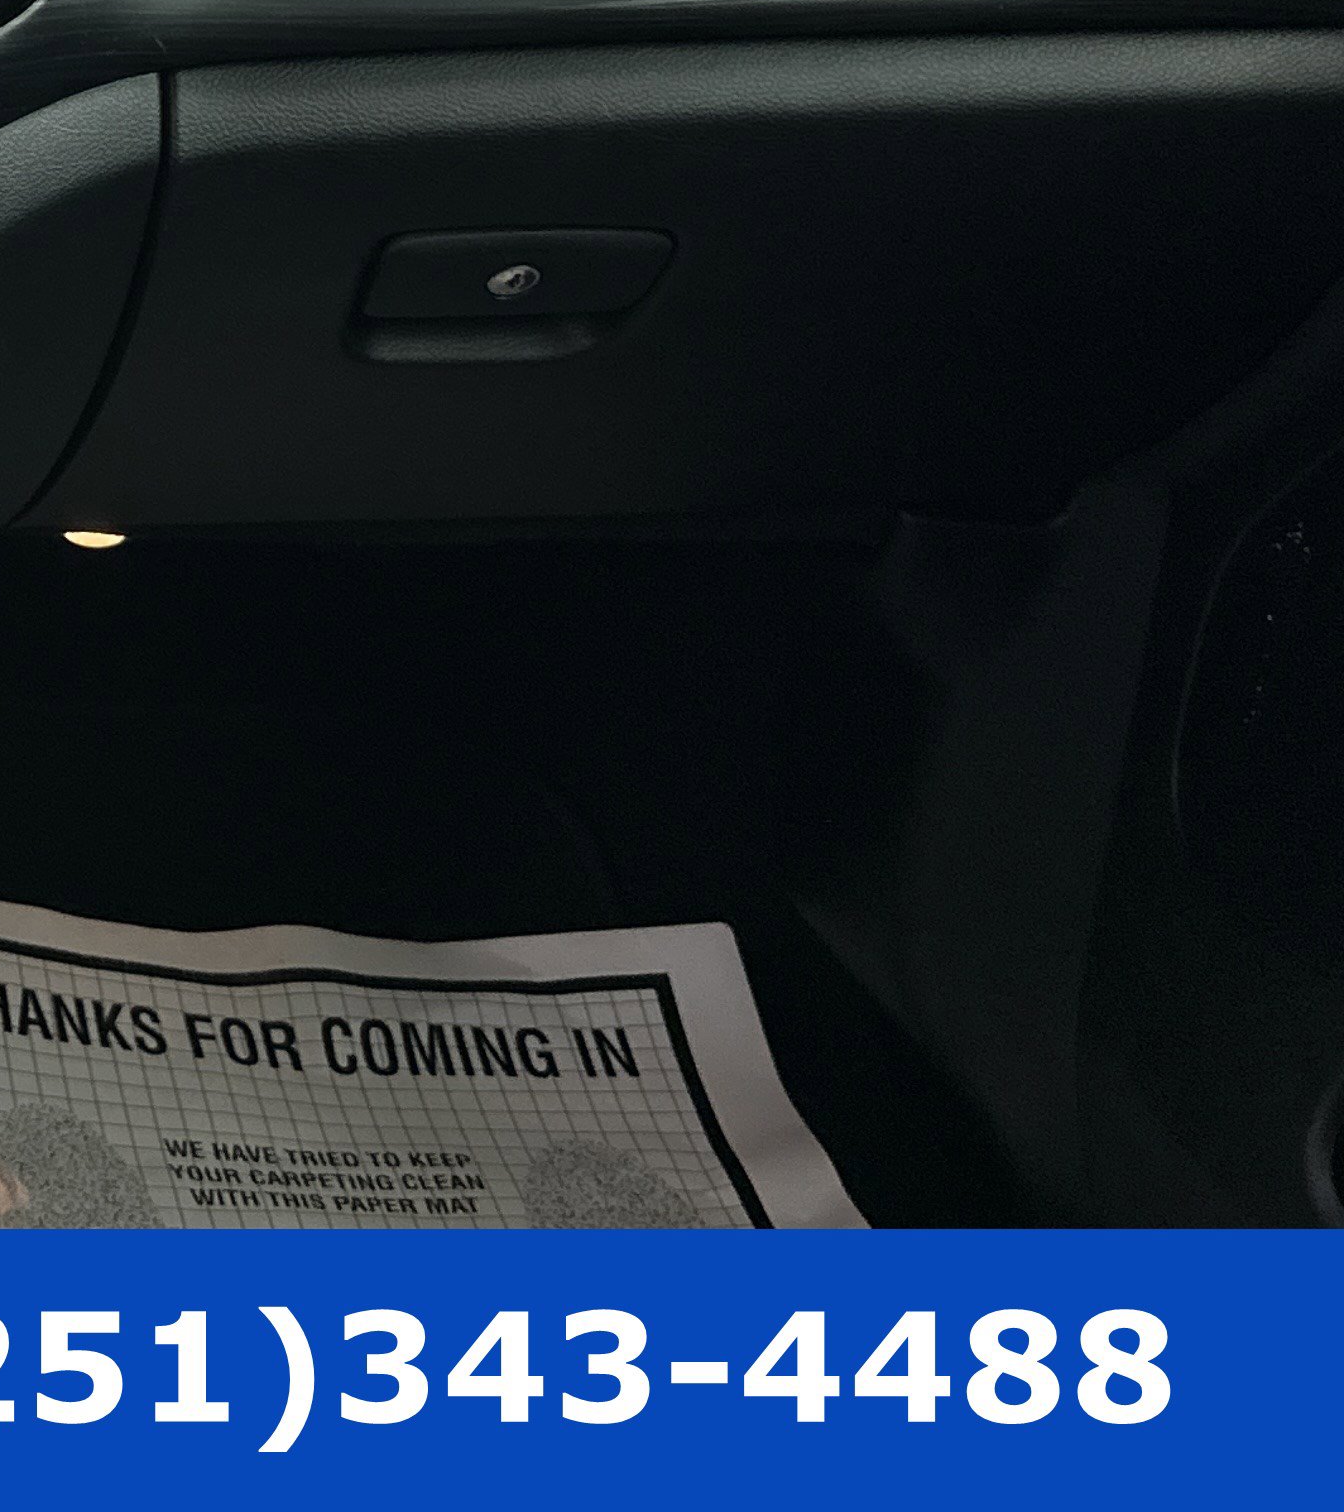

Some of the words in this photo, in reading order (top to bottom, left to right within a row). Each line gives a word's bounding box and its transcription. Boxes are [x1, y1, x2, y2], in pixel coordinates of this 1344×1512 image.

[184, 1012, 304, 1073] FOR
[322, 1014, 561, 1078] COMING
[573, 1025, 642, 1079] IN
[163, 1138, 207, 1159] WE
[212, 1142, 280, 1166] HAVE
[283, 1148, 360, 1168] TRIED
[366, 1150, 402, 1168] TO
[410, 1151, 472, 1168] KEEP
[167, 1162, 243, 1186] YOUR
[248, 1167, 394, 1192] CARPETING
[403, 1172, 486, 1192] CLEAN
[189, 1187, 260, 1208] WITH
[268, 1190, 325, 1211] THIS
[332, 1194, 418, 1215] PAPER
[424, 1195, 480, 1214] MAT
